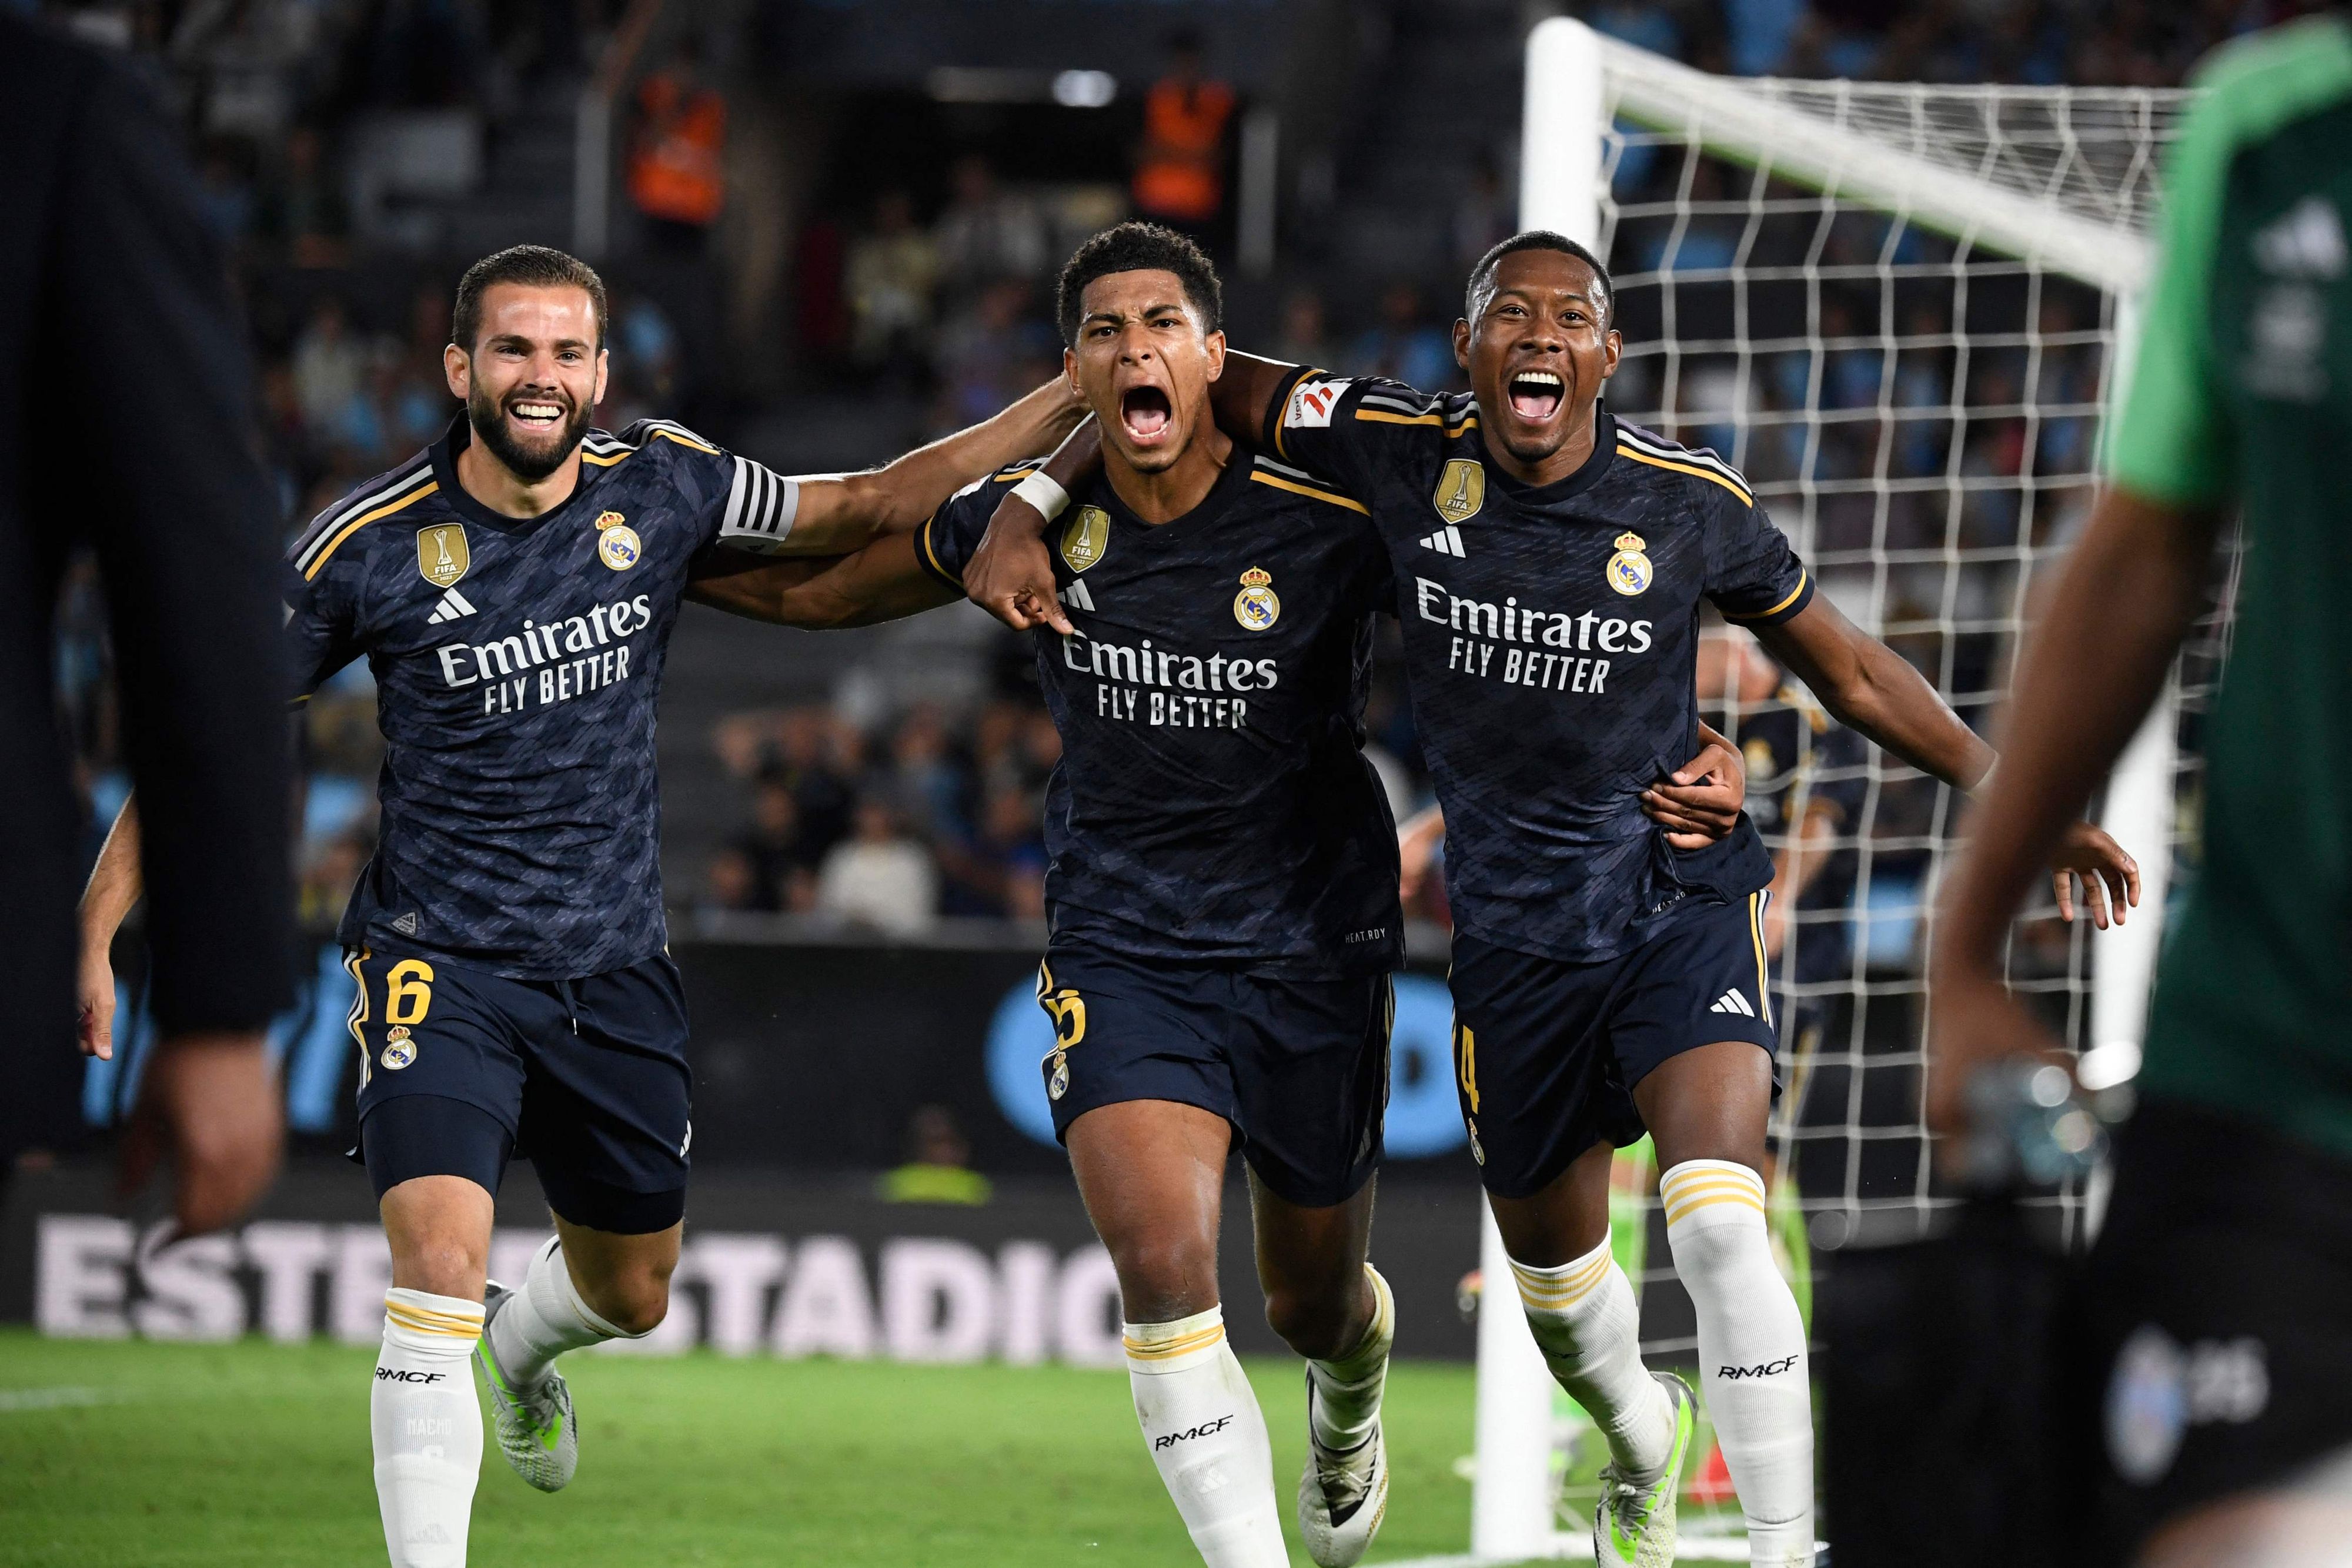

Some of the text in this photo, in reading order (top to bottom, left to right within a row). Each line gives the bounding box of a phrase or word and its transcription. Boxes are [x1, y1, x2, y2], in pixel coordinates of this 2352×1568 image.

[1446, 499, 1468, 510] FIFA
[435, 564, 457, 574] FIFA
[1071, 546, 1091, 557] FIFA
[1415, 576, 1652, 653] Emirates
[436, 594, 652, 687] Emirates
[1063, 629, 1278, 691] Emirates
[485, 646, 629, 716] FLY BETTER
[1449, 636, 1611, 694] FLY BETTER
[1098, 684, 1247, 729] FLY BETTER
[1652, 887, 1690, 915] HEAT.RD
[1345, 927, 1386, 944] HEAT.RDY
[386, 959, 434, 1025] 6
[1461, 1024, 1480, 1115] 4
[35, 1212, 396, 1344] ESTE
[375, 1367, 446, 1384] RMCF
[1718, 1354, 1799, 1380] RMCF
[1155, 1414, 1234, 1452] RMCF
